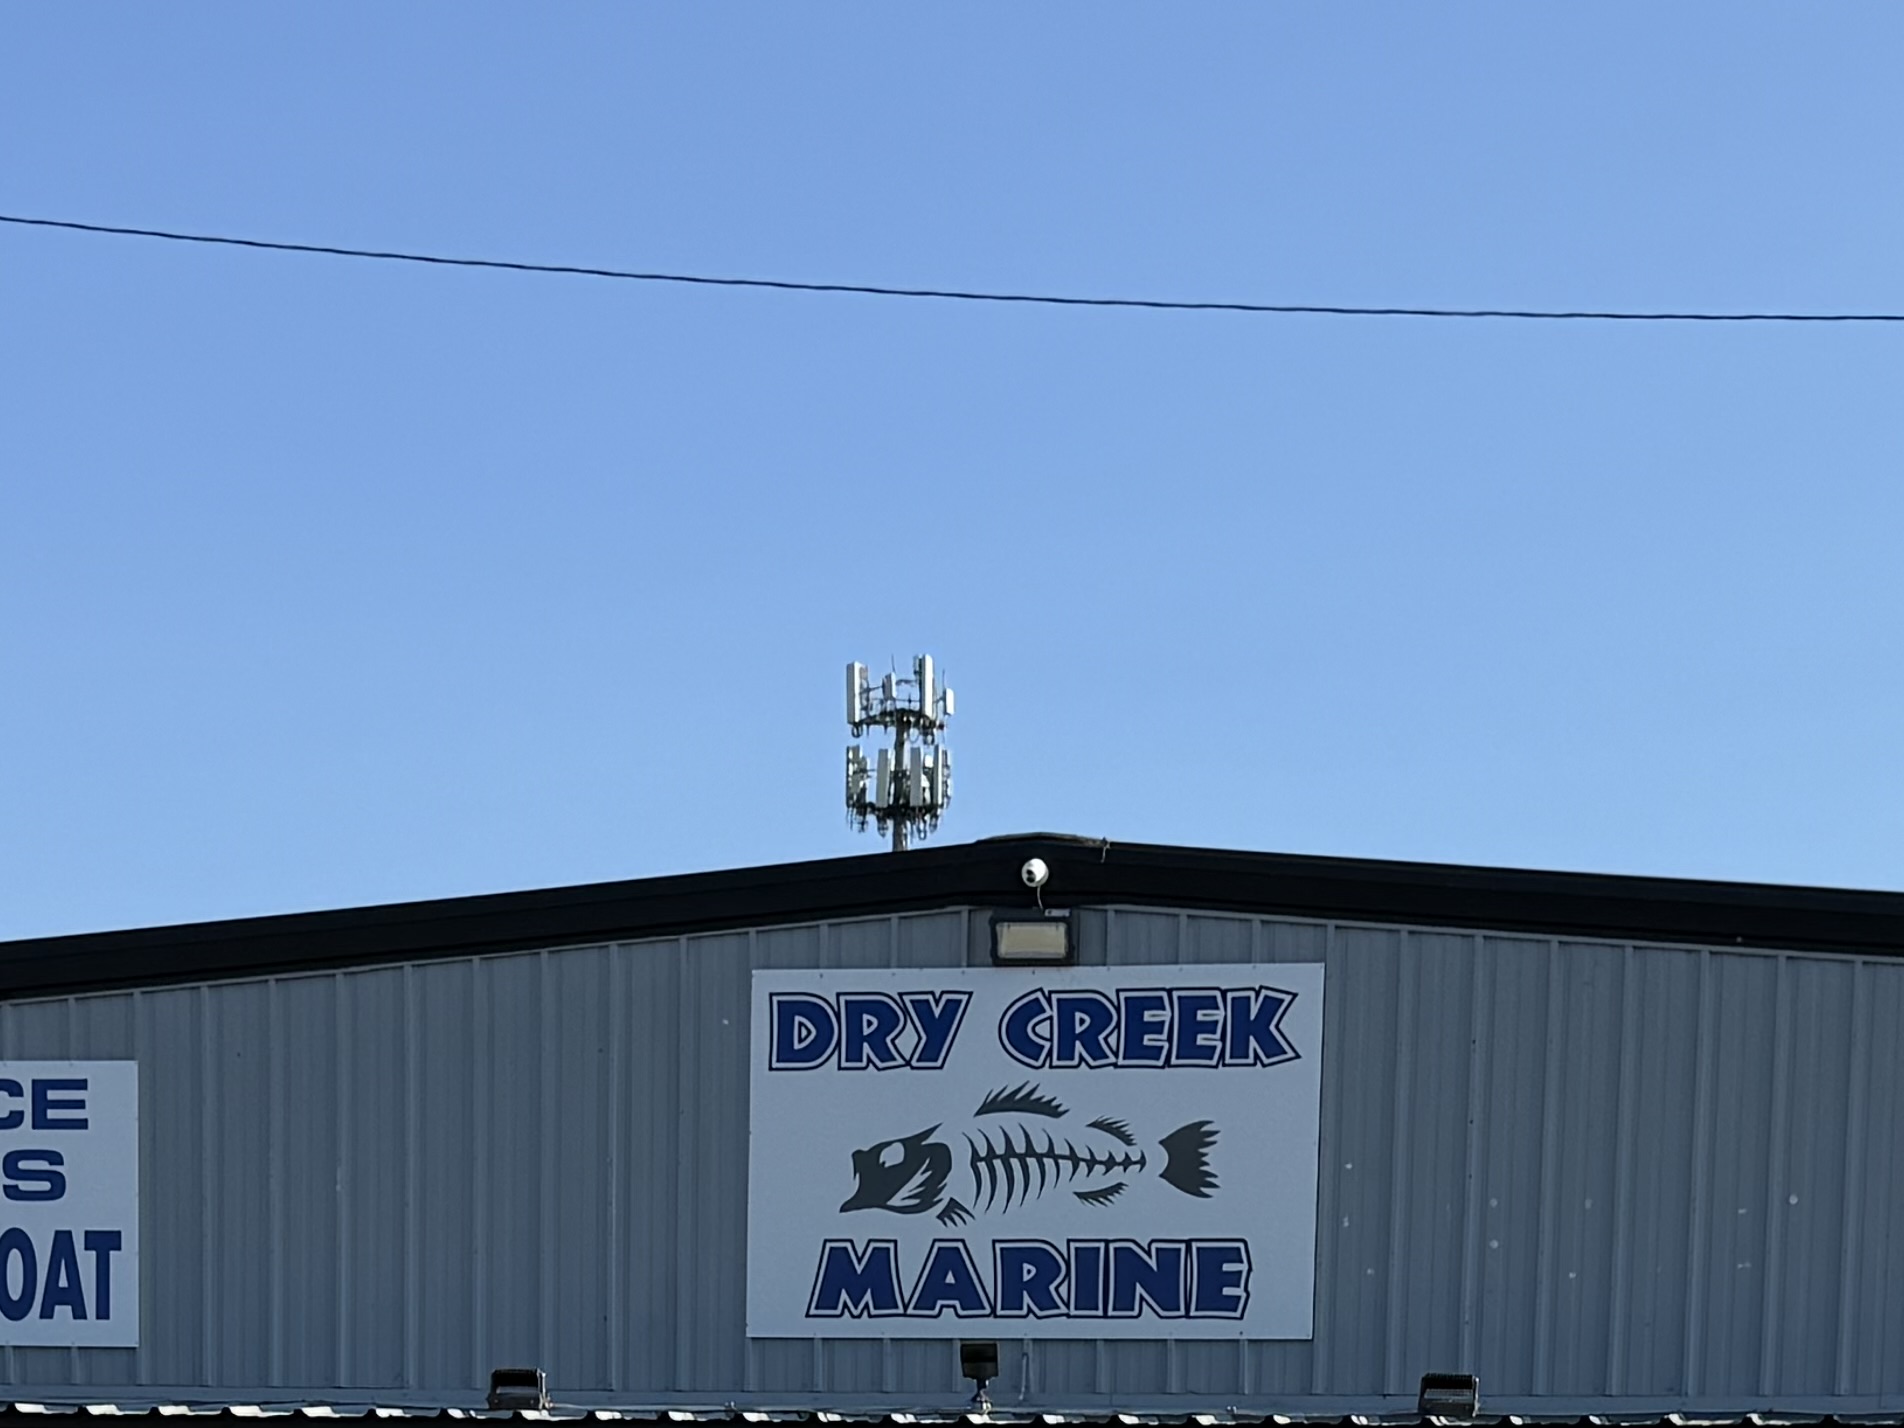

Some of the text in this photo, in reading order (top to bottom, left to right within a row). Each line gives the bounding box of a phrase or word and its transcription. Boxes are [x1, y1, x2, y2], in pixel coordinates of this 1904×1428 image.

[768, 986, 1302, 1071] DRY CREEK
[804, 1237, 1252, 1320] MARINE
